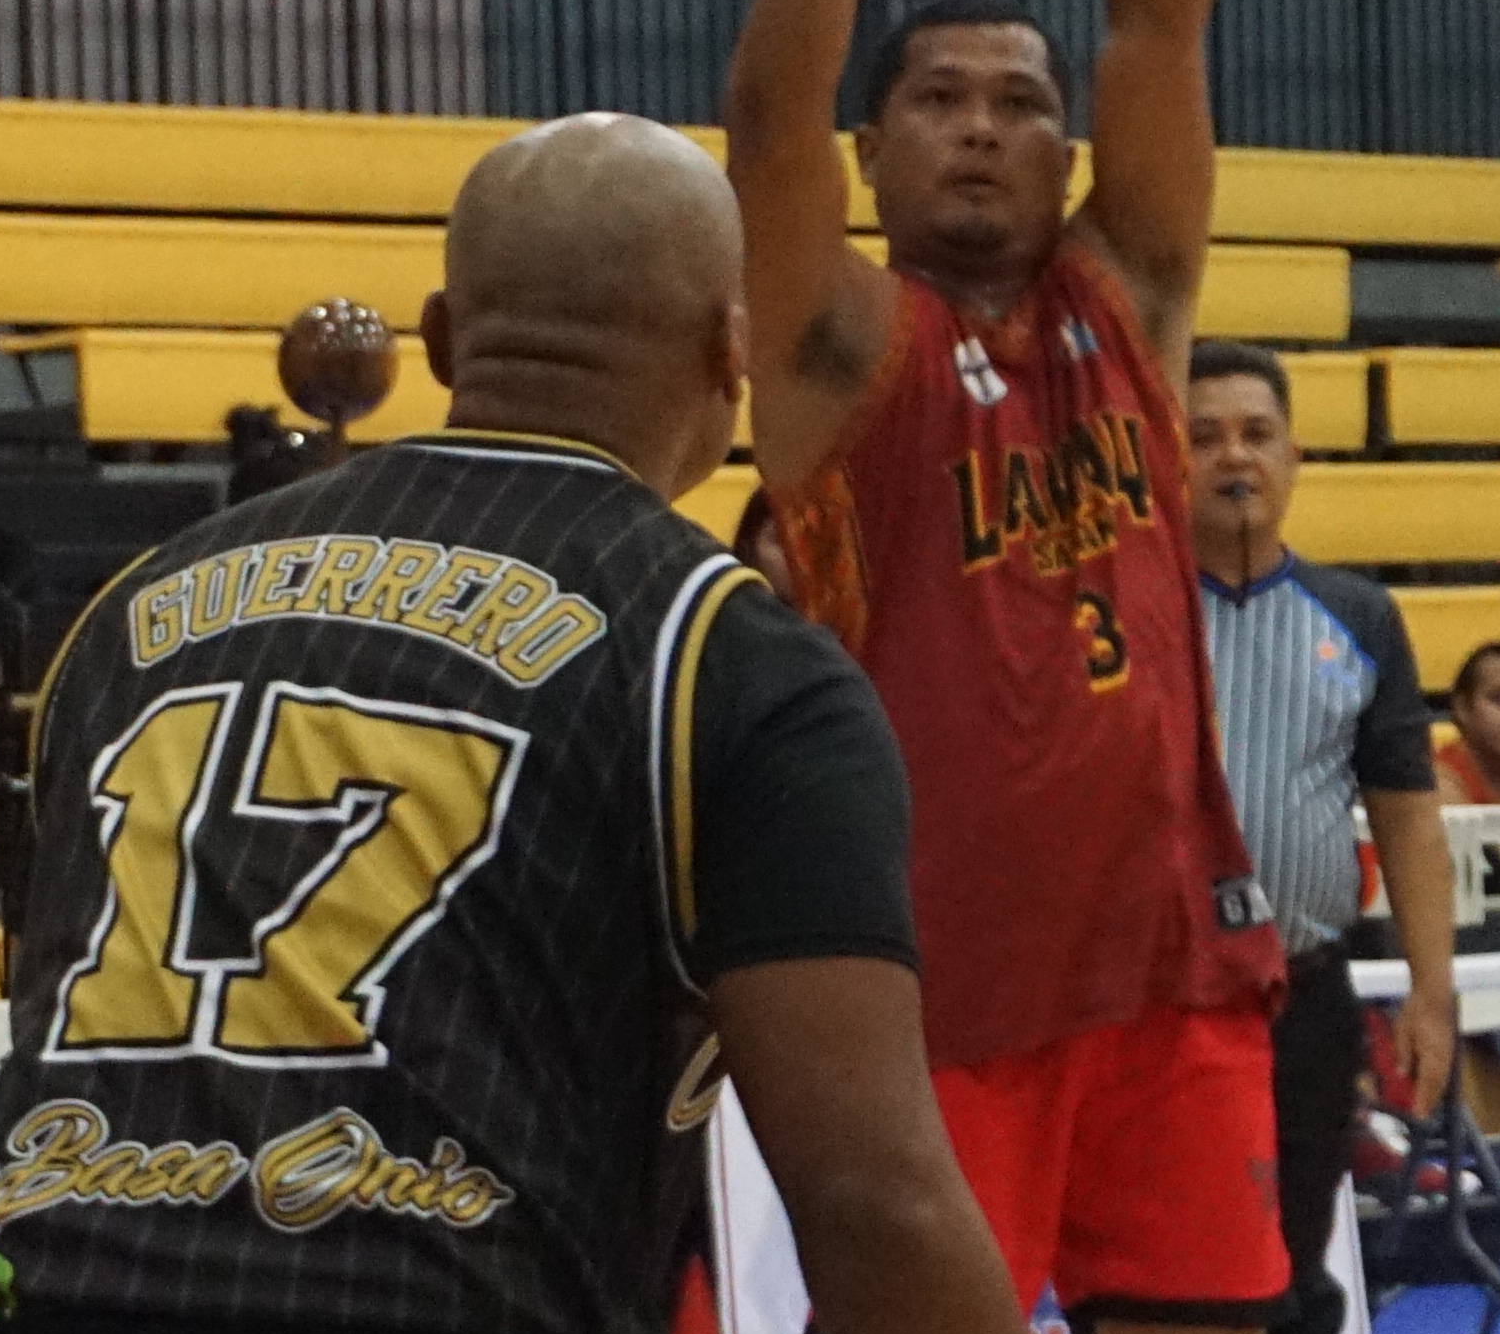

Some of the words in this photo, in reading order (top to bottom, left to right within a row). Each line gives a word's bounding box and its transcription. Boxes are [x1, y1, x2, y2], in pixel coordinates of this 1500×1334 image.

[129, 534, 607, 689] GUERRERO
[1073, 591, 1131, 694] 3
[41, 681, 530, 1067] 17
